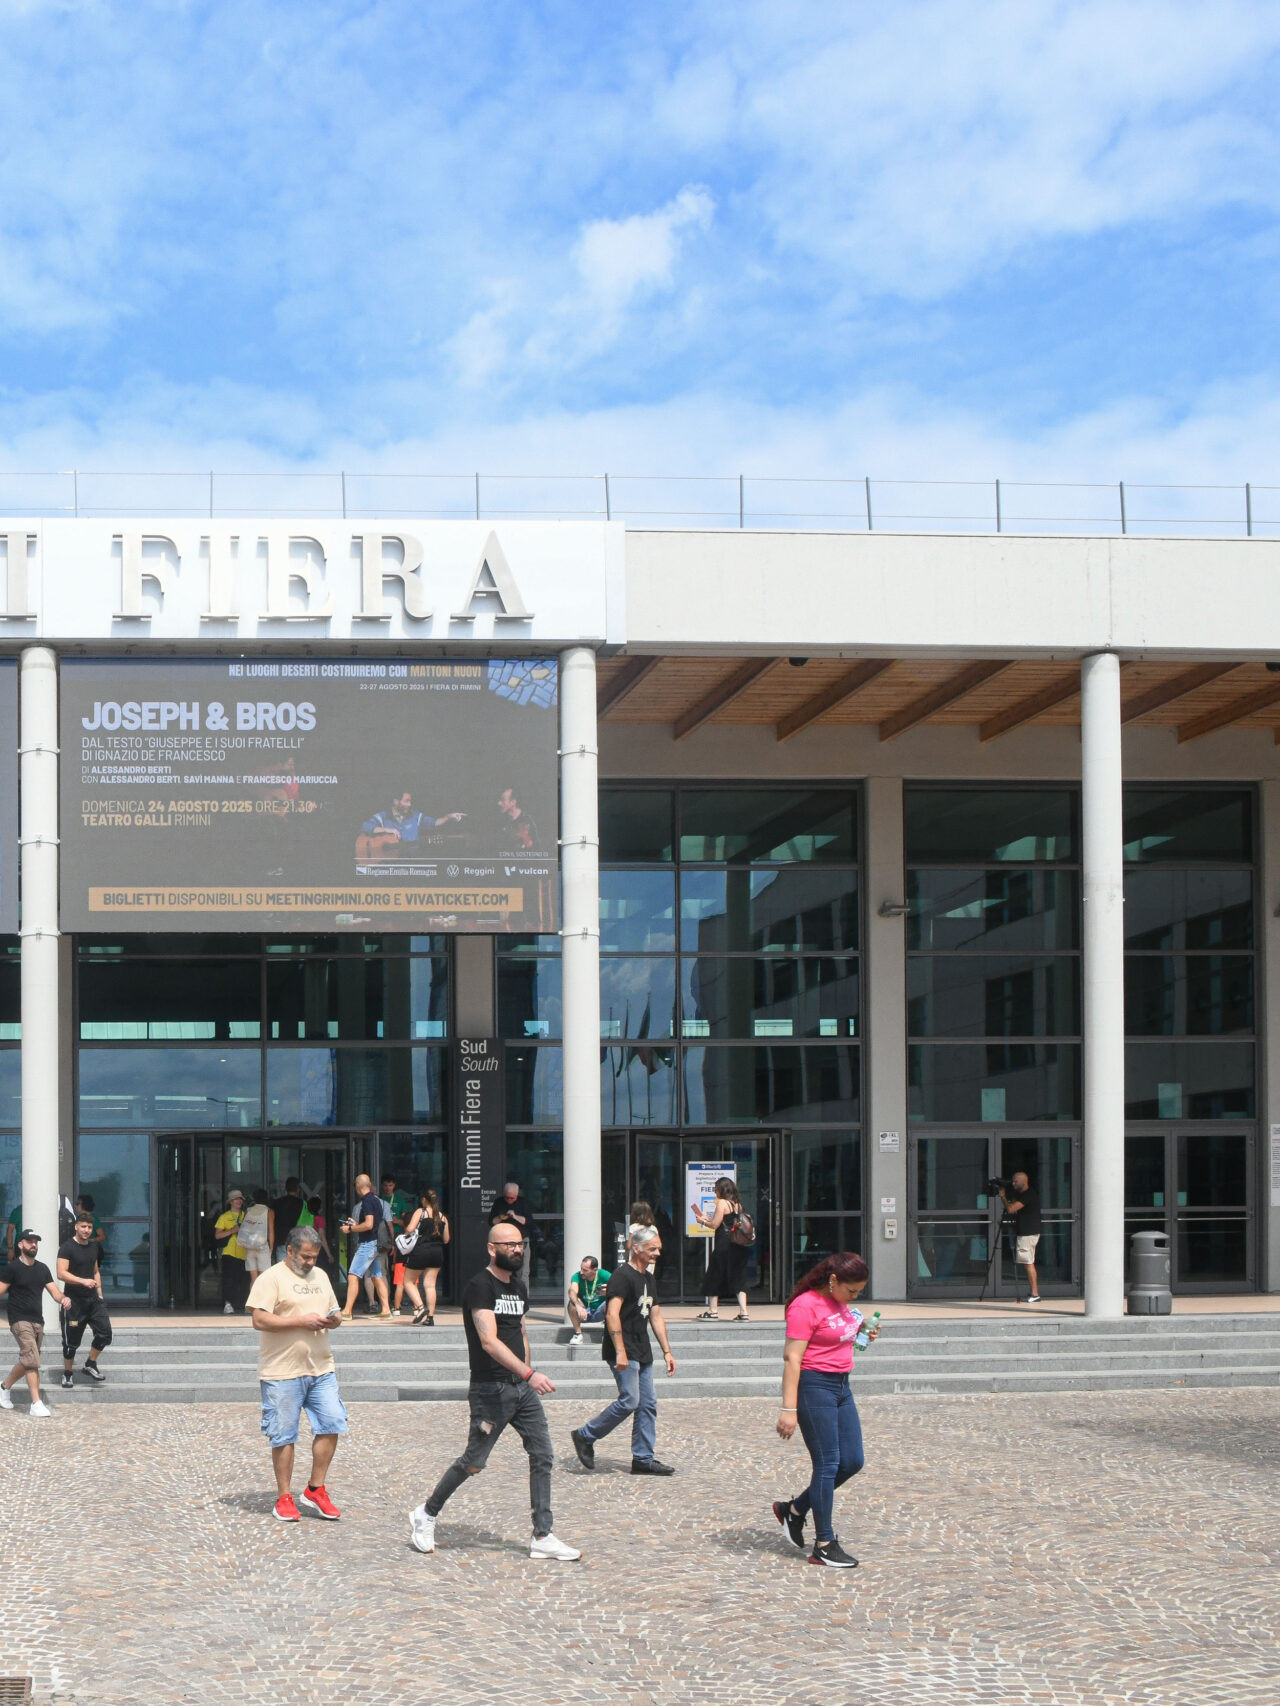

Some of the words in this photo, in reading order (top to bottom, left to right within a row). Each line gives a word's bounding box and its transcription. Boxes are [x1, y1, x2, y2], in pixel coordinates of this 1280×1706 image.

[112, 530, 535, 623] FIERA
[229, 665, 243, 677] NEI
[246, 665, 279, 677] LUOGHI
[282, 665, 318, 677] DESERTI
[321, 665, 386, 677] COSTRUIREMO
[388, 665, 408, 677] CON
[410, 665, 451, 677] MATTONI
[454, 665, 481, 677] NUOVI
[82, 702, 200, 731] JOSEPH
[205, 702, 230, 731] &
[236, 702, 317, 731] BROS
[82, 737, 104, 748] DAL
[106, 737, 142, 748] TESTO
[205, 737, 211, 748] E
[220, 737, 246, 748] SUOI
[82, 750, 93, 761] DI
[94, 750, 138, 761] IGNAZIO
[141, 750, 156, 761] DE
[158, 750, 226, 761] FRANCESCO
[81, 766, 90, 774] DI
[91, 766, 147, 774] ALESSANDRO
[148, 766, 172, 774] BERTI
[81, 776, 99, 784] CON
[100, 776, 155, 784] ALESSANDRO
[204, 776, 234, 784] MANNA
[236, 776, 241, 784] E
[243, 776, 292, 784] FRANCESCO
[293, 776, 338, 784] MARIUCCIA
[82, 801, 145, 813] DOMENICA
[148, 801, 165, 813] 24
[168, 801, 219, 813] AGOSTO
[222, 801, 253, 813] 2025
[255, 801, 280, 813] ORE
[283, 801, 313, 813] 21.30
[82, 814, 132, 826] TEATRO
[134, 814, 172, 826] GALLI
[174, 814, 211, 826] RIMINI
[464, 866, 495, 876] Reggini
[519, 867, 549, 875] vulcan
[104, 893, 165, 905] BIGLIETTI
[169, 893, 243, 905] DISPONIBILI
[246, 893, 263, 905] SU
[266, 893, 391, 905] MEETINGRIMINI.ORG
[394, 893, 402, 905] E
[405, 893, 509, 905] VIVATICKET.COM
[461, 1039, 487, 1054] Sud
[461, 1057, 499, 1072] South
[461, 1079, 481, 1124] Fiera
[461, 1130, 481, 1189] Rimini
[293, 1284, 323, 1294] Calvin
